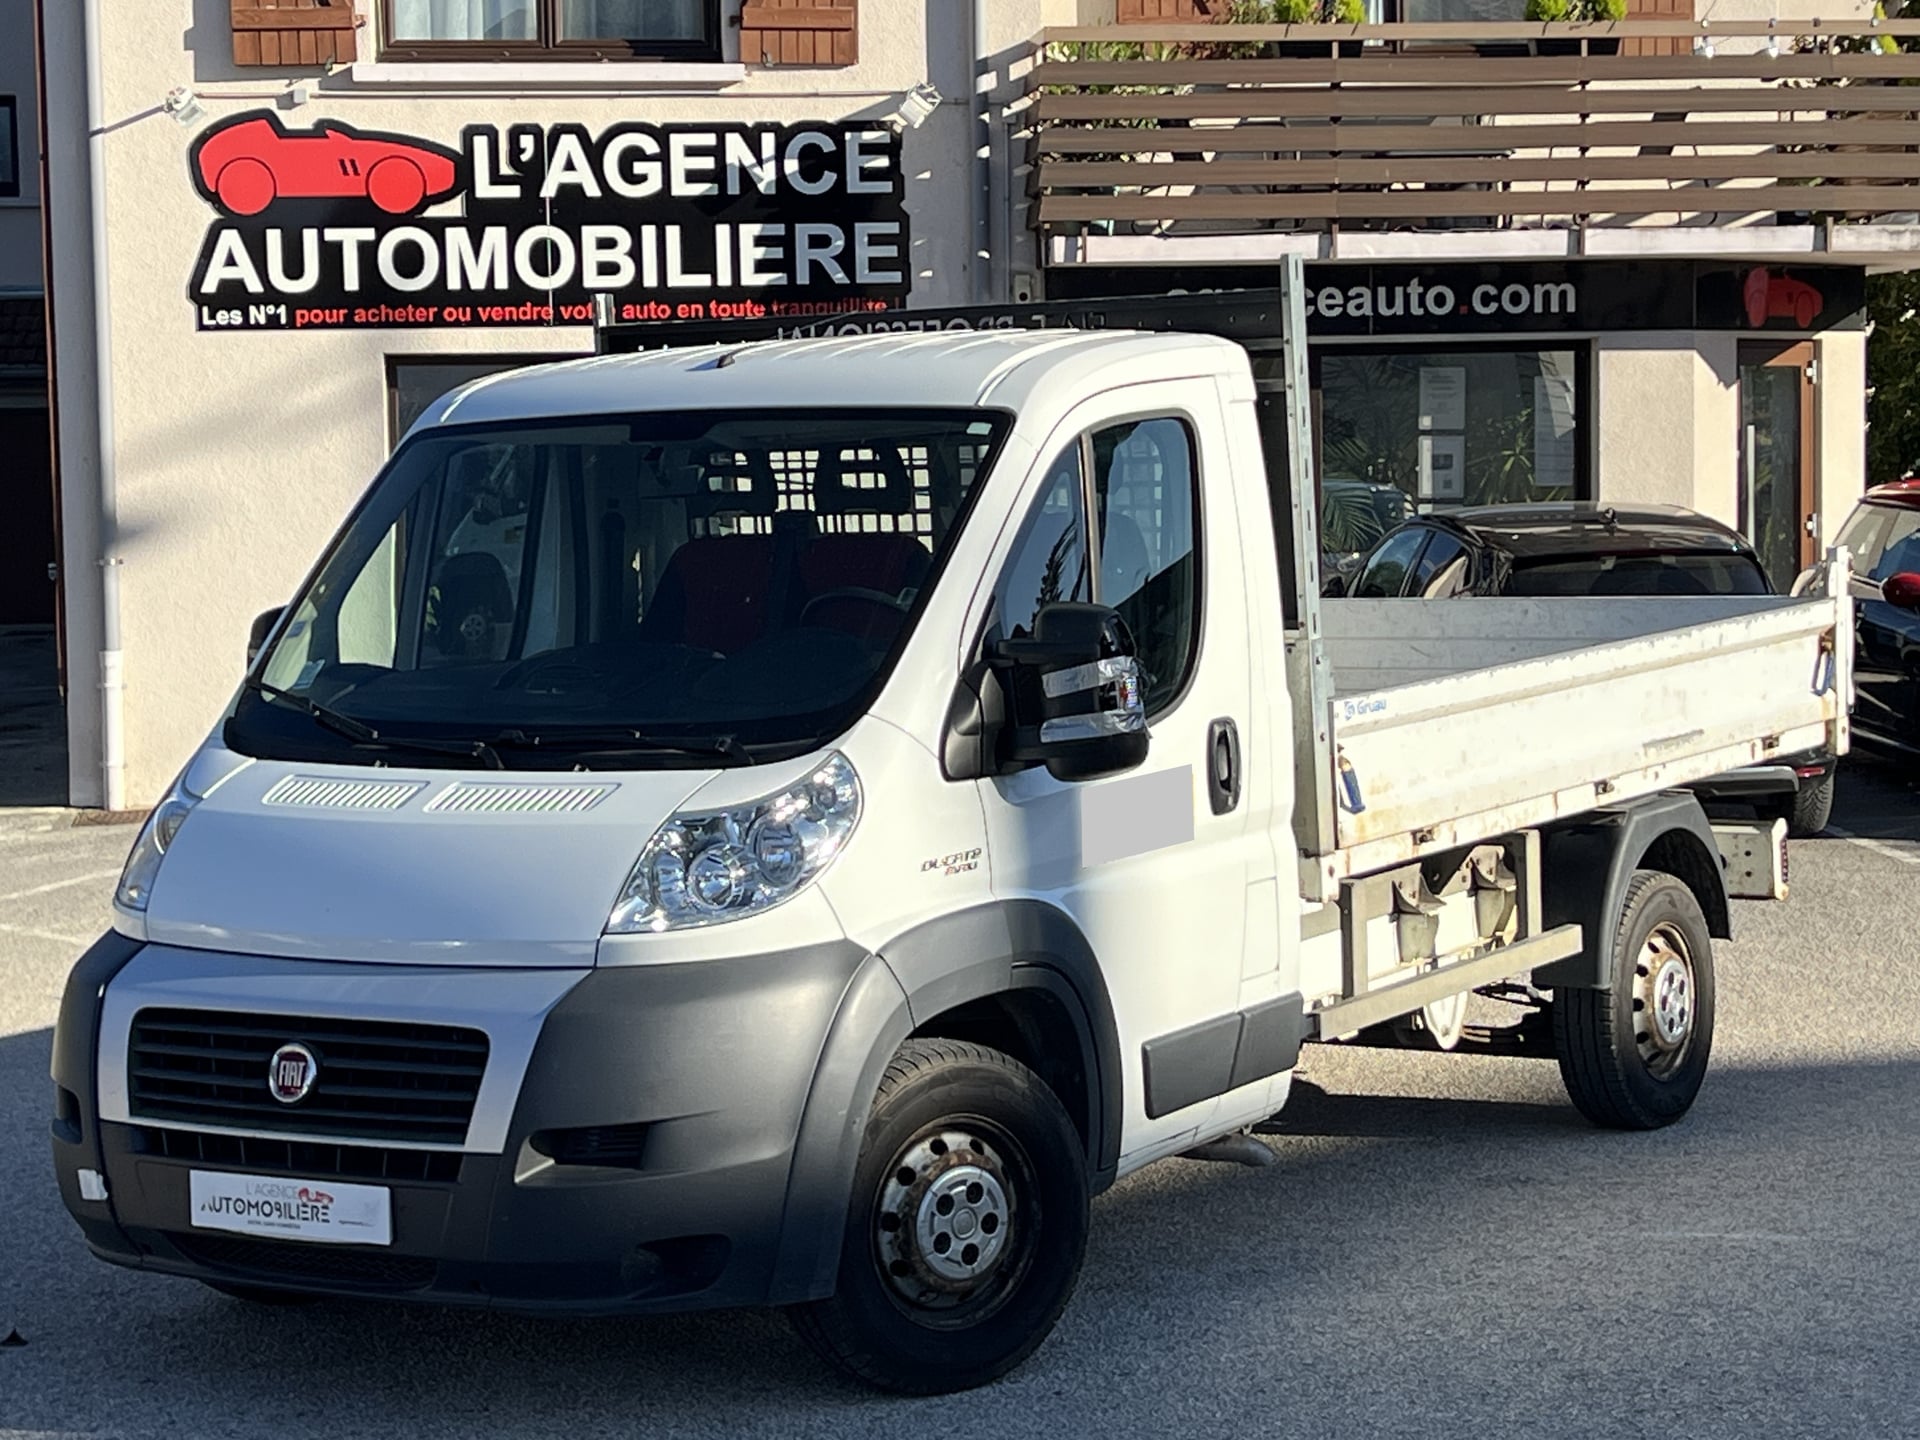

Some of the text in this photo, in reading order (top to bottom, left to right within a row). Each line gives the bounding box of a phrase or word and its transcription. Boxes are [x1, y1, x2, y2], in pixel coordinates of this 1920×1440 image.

[472, 131, 894, 199] L'AGENCE
[199, 221, 902, 295] AUTOMOBILIERE
[201, 305, 243, 326] Les
[294, 307, 348, 328] pour
[353, 304, 438, 323] acheter
[442, 305, 472, 322] ou
[477, 302, 554, 322] vendre
[622, 301, 671, 319] auto
[676, 302, 703, 319] en
[708, 299, 766, 318] toute
[278, 1060, 307, 1087] FIAT
[200, 1195, 331, 1224] AUTOMOBILIERE
